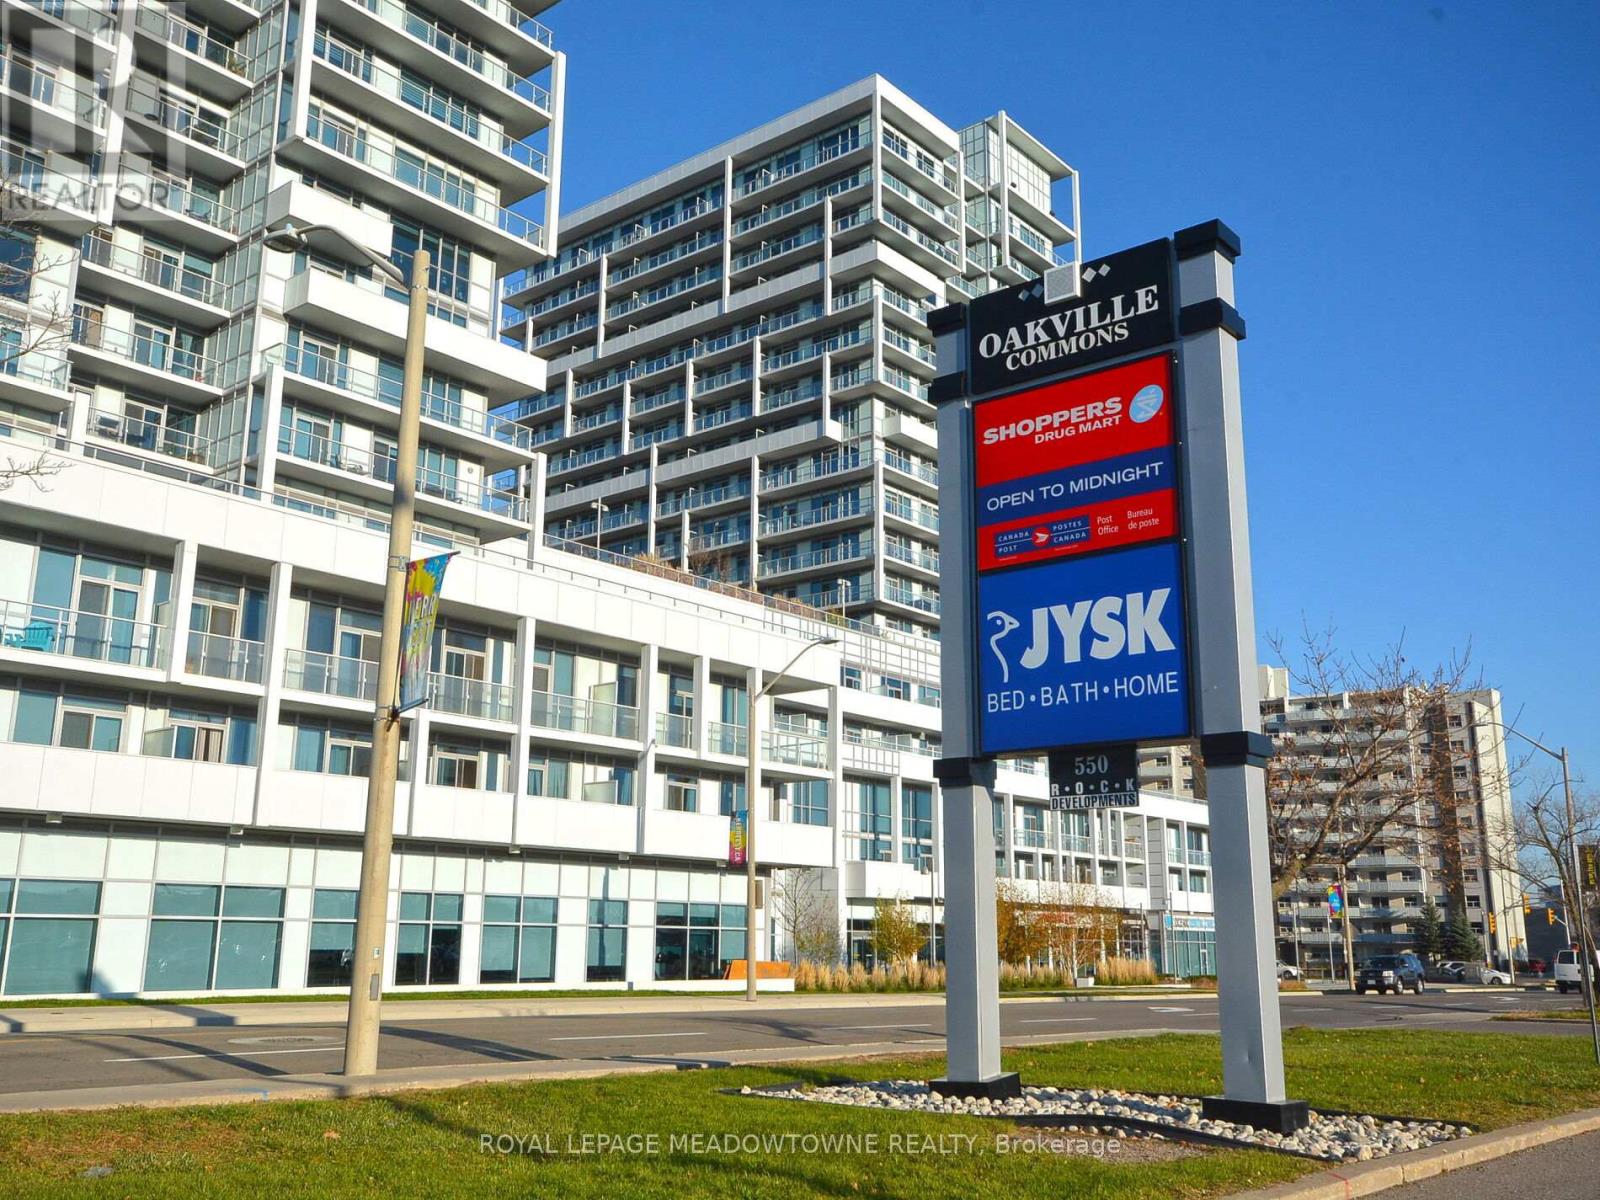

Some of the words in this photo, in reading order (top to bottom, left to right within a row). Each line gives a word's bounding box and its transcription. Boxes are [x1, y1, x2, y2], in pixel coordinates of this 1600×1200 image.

[978, 284, 1159, 359] OAKVILLE
[1005, 321, 1129, 372] COMMONS
[982, 396, 1122, 445] SHOPPERS
[1034, 425, 1075, 445] DRUG
[1078, 414, 1122, 434] MART
[986, 489, 1034, 512] OPEN
[1040, 483, 1064, 500] TO
[1069, 461, 1164, 493] MIDNIGHT
[1096, 515, 1113, 526] Post
[1126, 508, 1153, 519] Bureau
[1052, 520, 1082, 532] POSTES
[1097, 524, 1119, 536] Office
[1127, 520, 1138, 530] de
[1138, 517, 1160, 530] poste
[997, 531, 1030, 543] CANADA
[1053, 532, 1087, 544] CANADA
[998, 545, 1018, 554] POST
[1019, 587, 1176, 670] JYSK
[987, 690, 1025, 713] BED
[1040, 681, 1099, 707] BATH
[1114, 671, 1179, 699] HOME
[1074, 755, 1109, 776] 550
[1051, 793, 1136, 810] DEVELOPMENTS
